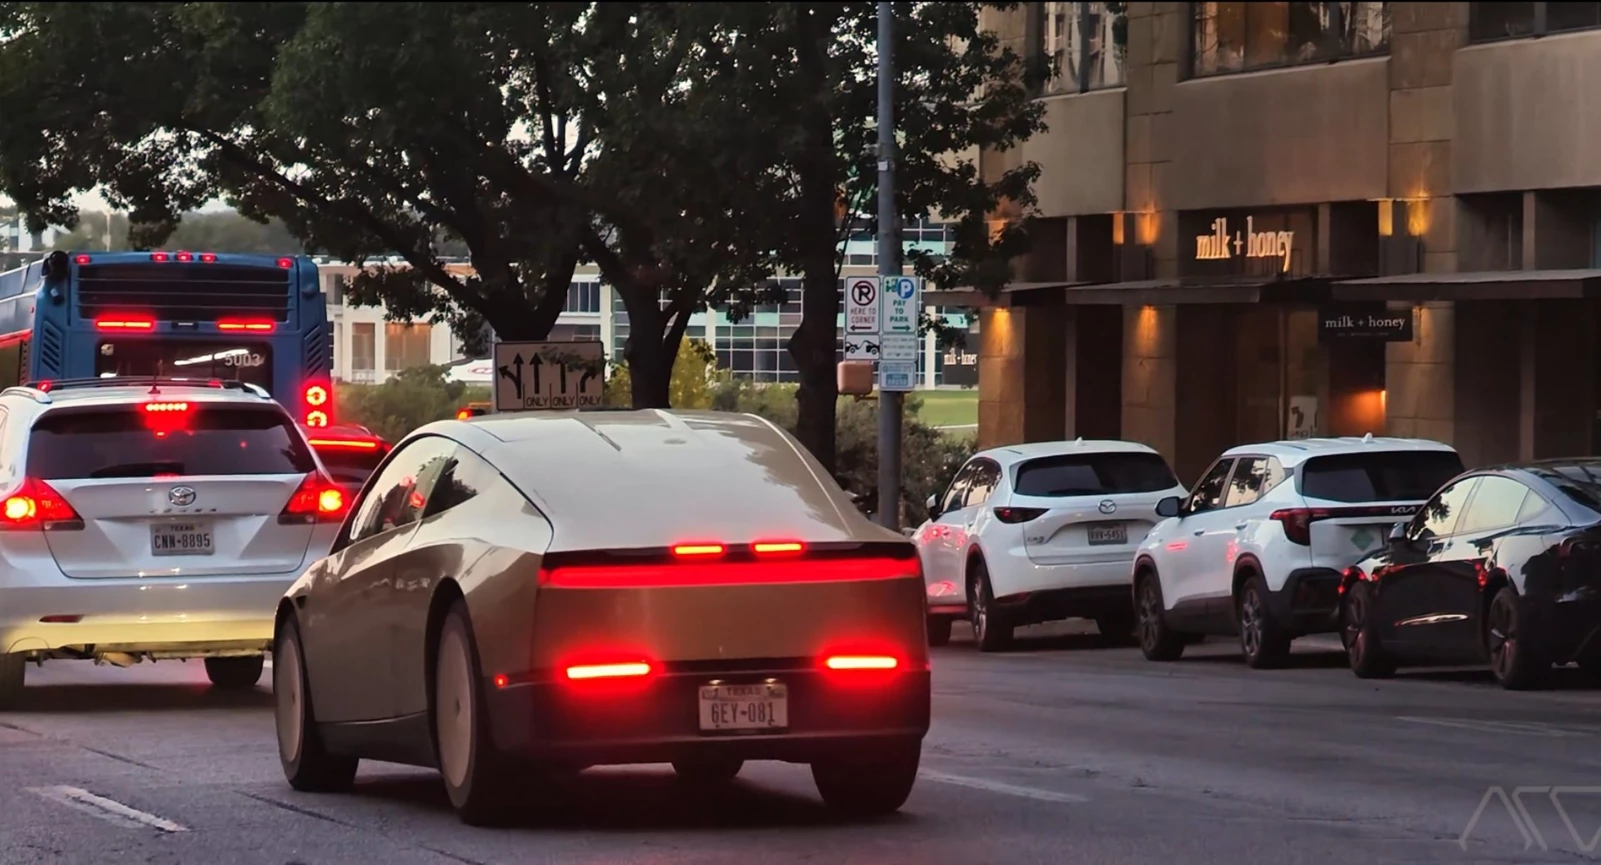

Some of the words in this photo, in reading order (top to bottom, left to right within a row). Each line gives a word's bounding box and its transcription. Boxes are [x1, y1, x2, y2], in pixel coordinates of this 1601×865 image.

[1196, 217, 1231, 259] milk
[1233, 230, 1243, 255] +
[1246, 215, 1294, 272] honey
[850, 307, 866, 315] HERE
[868, 307, 877, 315] TO
[851, 316, 875, 324] CORNER
[889, 315, 909, 323] PARK
[1325, 315, 1354, 328] milk
[1368, 315, 1405, 331] honey
[224, 353, 261, 367] 5003
[526, 395, 549, 407] ONLY
[552, 395, 575, 407] ONLY
[579, 395, 601, 406] ONLY
[170, 524, 195, 532] TEXAS
